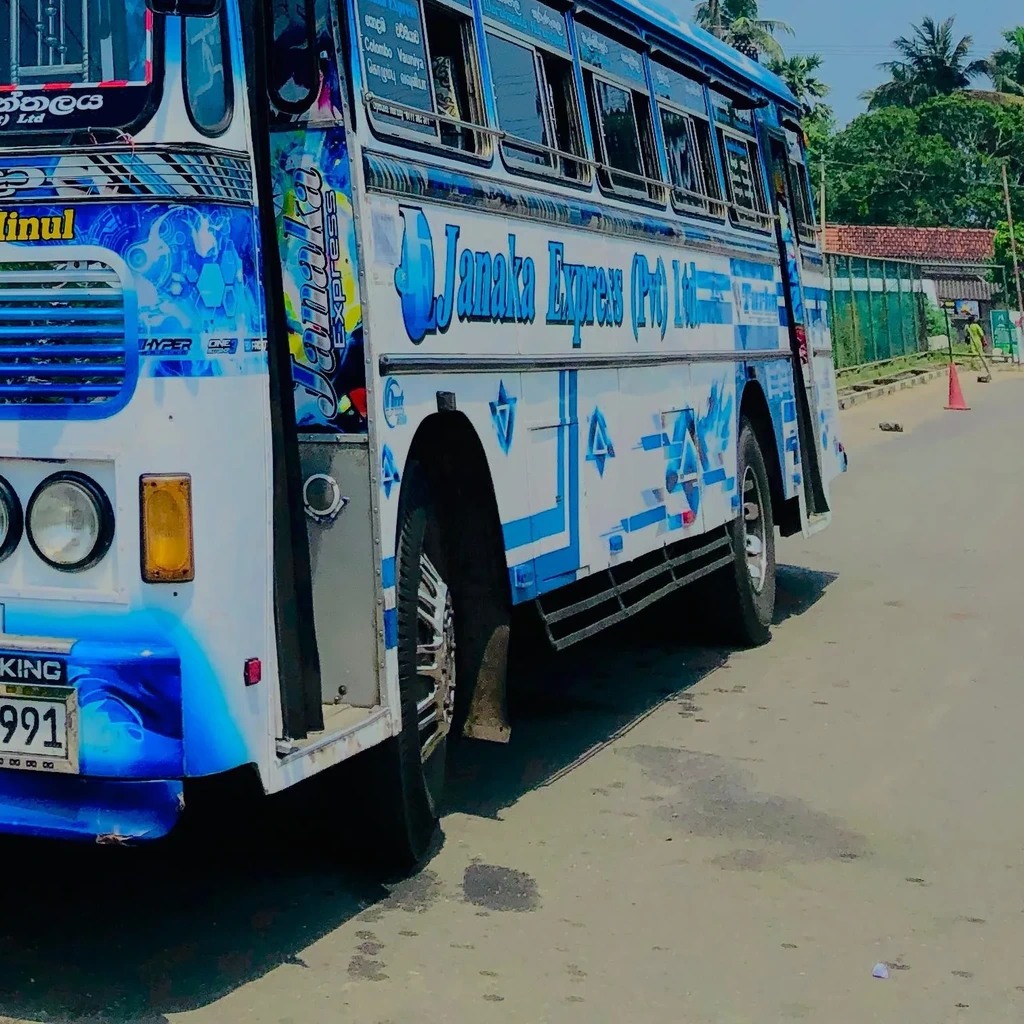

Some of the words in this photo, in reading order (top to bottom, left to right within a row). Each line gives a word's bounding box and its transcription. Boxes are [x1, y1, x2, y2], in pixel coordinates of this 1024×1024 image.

[364, 36, 393, 59] Colombo
[16, 113, 45, 125] Ltd
[283, 166, 339, 420] Janaka
[326, 189, 347, 350] Express
[436, 223, 537, 328] Janaka
[545, 240, 624, 349] Express
[630, 251, 669, 343] (Pvt)
